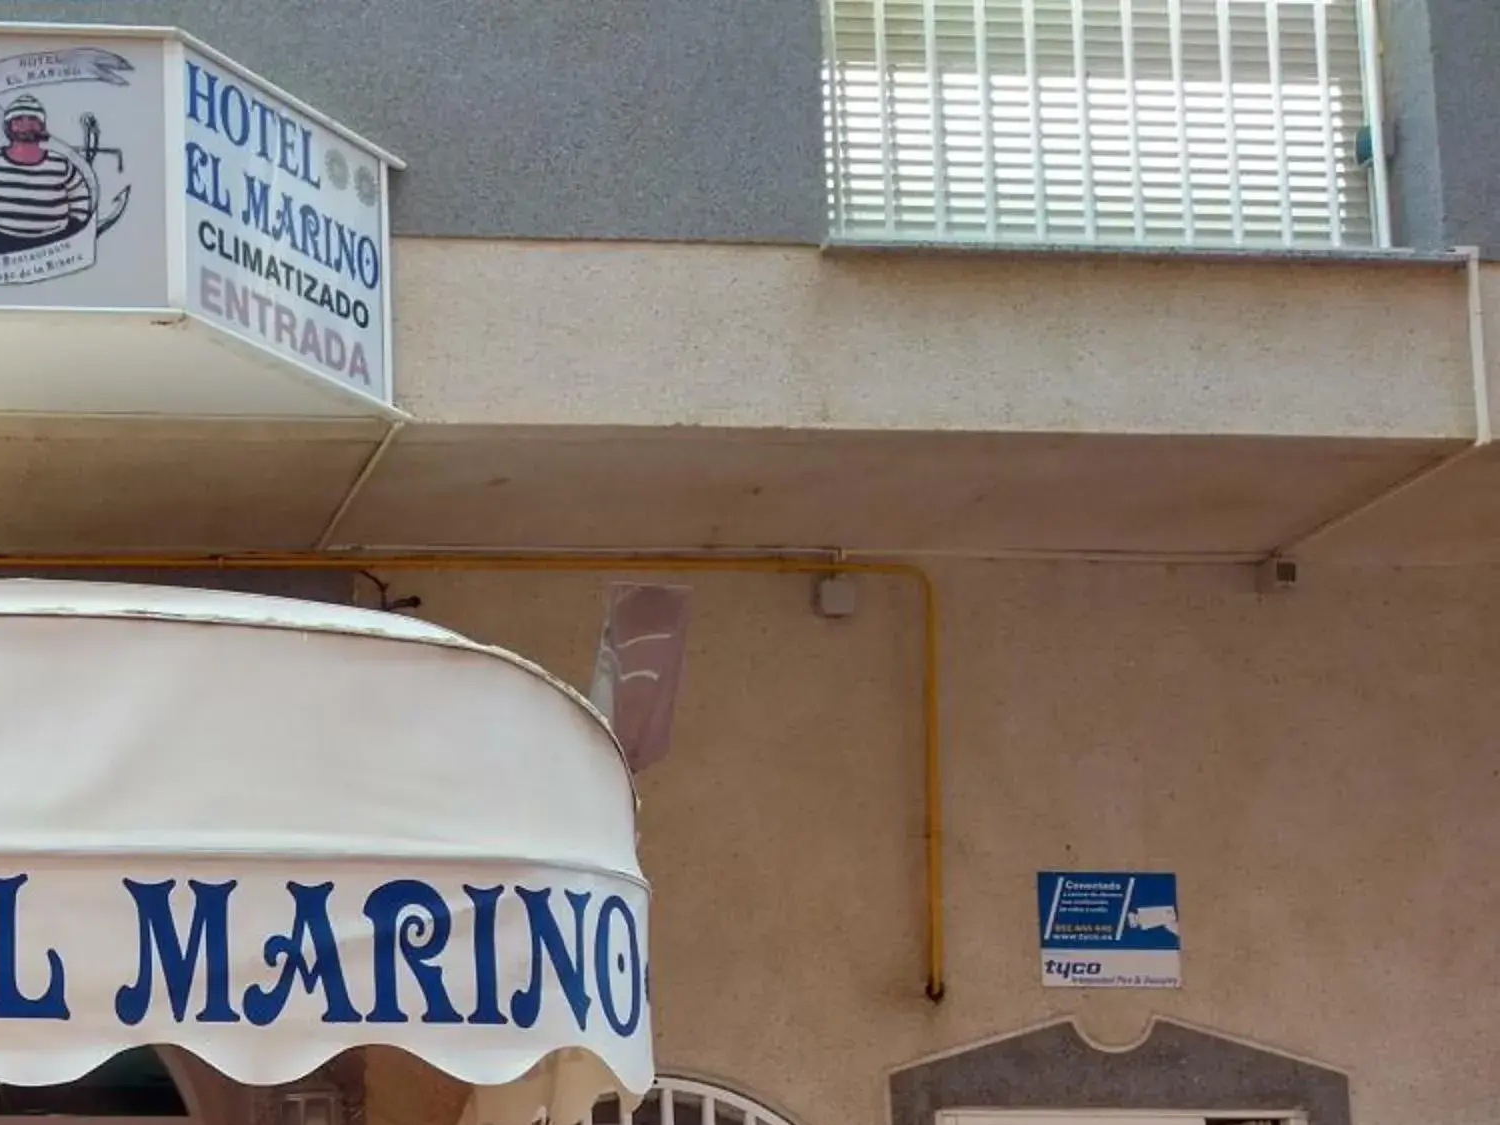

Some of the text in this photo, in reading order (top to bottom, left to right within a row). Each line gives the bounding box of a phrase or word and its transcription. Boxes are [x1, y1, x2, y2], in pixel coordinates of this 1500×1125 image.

[185, 60, 321, 189] HOTEL
[185, 142, 379, 290] EL MARINO
[199, 220, 370, 329] CLIMATIZADO
[200, 264, 371, 385] ENTRADA
[115, 877, 641, 1038] MARINO
[1044, 959, 1102, 979] tyco
